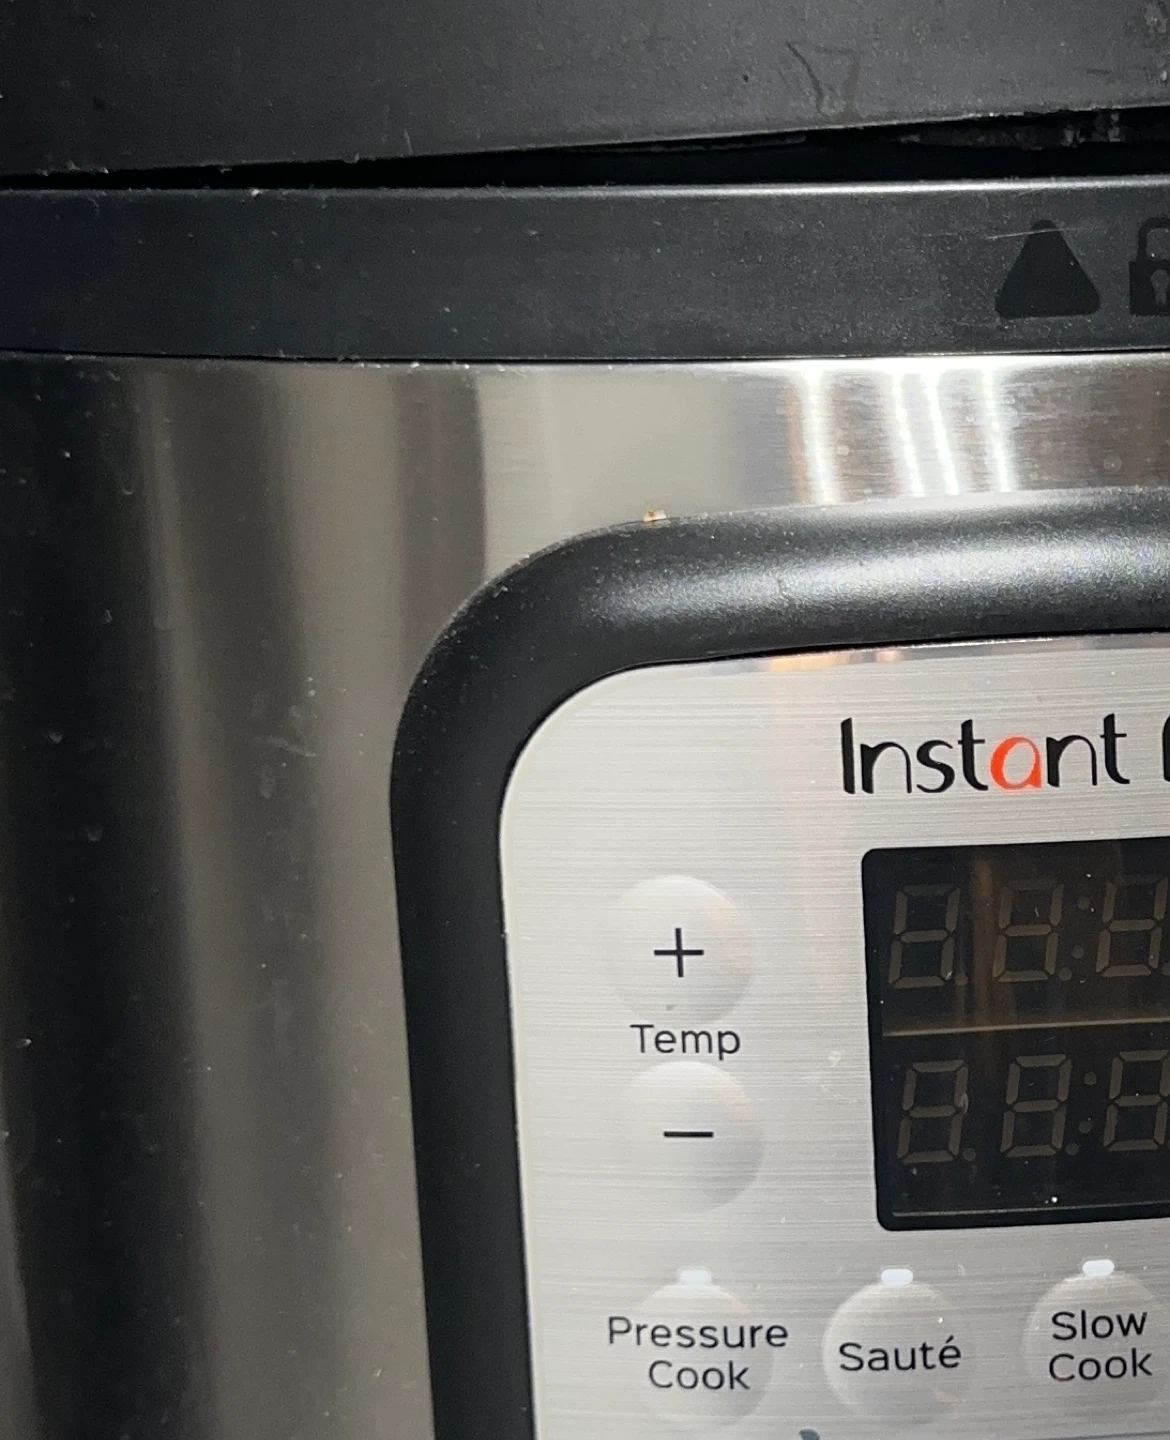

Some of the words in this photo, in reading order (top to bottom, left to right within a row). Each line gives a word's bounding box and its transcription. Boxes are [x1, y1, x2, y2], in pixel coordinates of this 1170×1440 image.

[841, 713, 1130, 794] Instant
[630, 1024, 740, 1061] Temp
[609, 1317, 788, 1348] Pressure
[1052, 1310, 1147, 1341] Slow
[840, 1335, 961, 1371] Sauté
[1049, 1348, 1152, 1381] Cook
[649, 1360, 750, 1390] Cook
